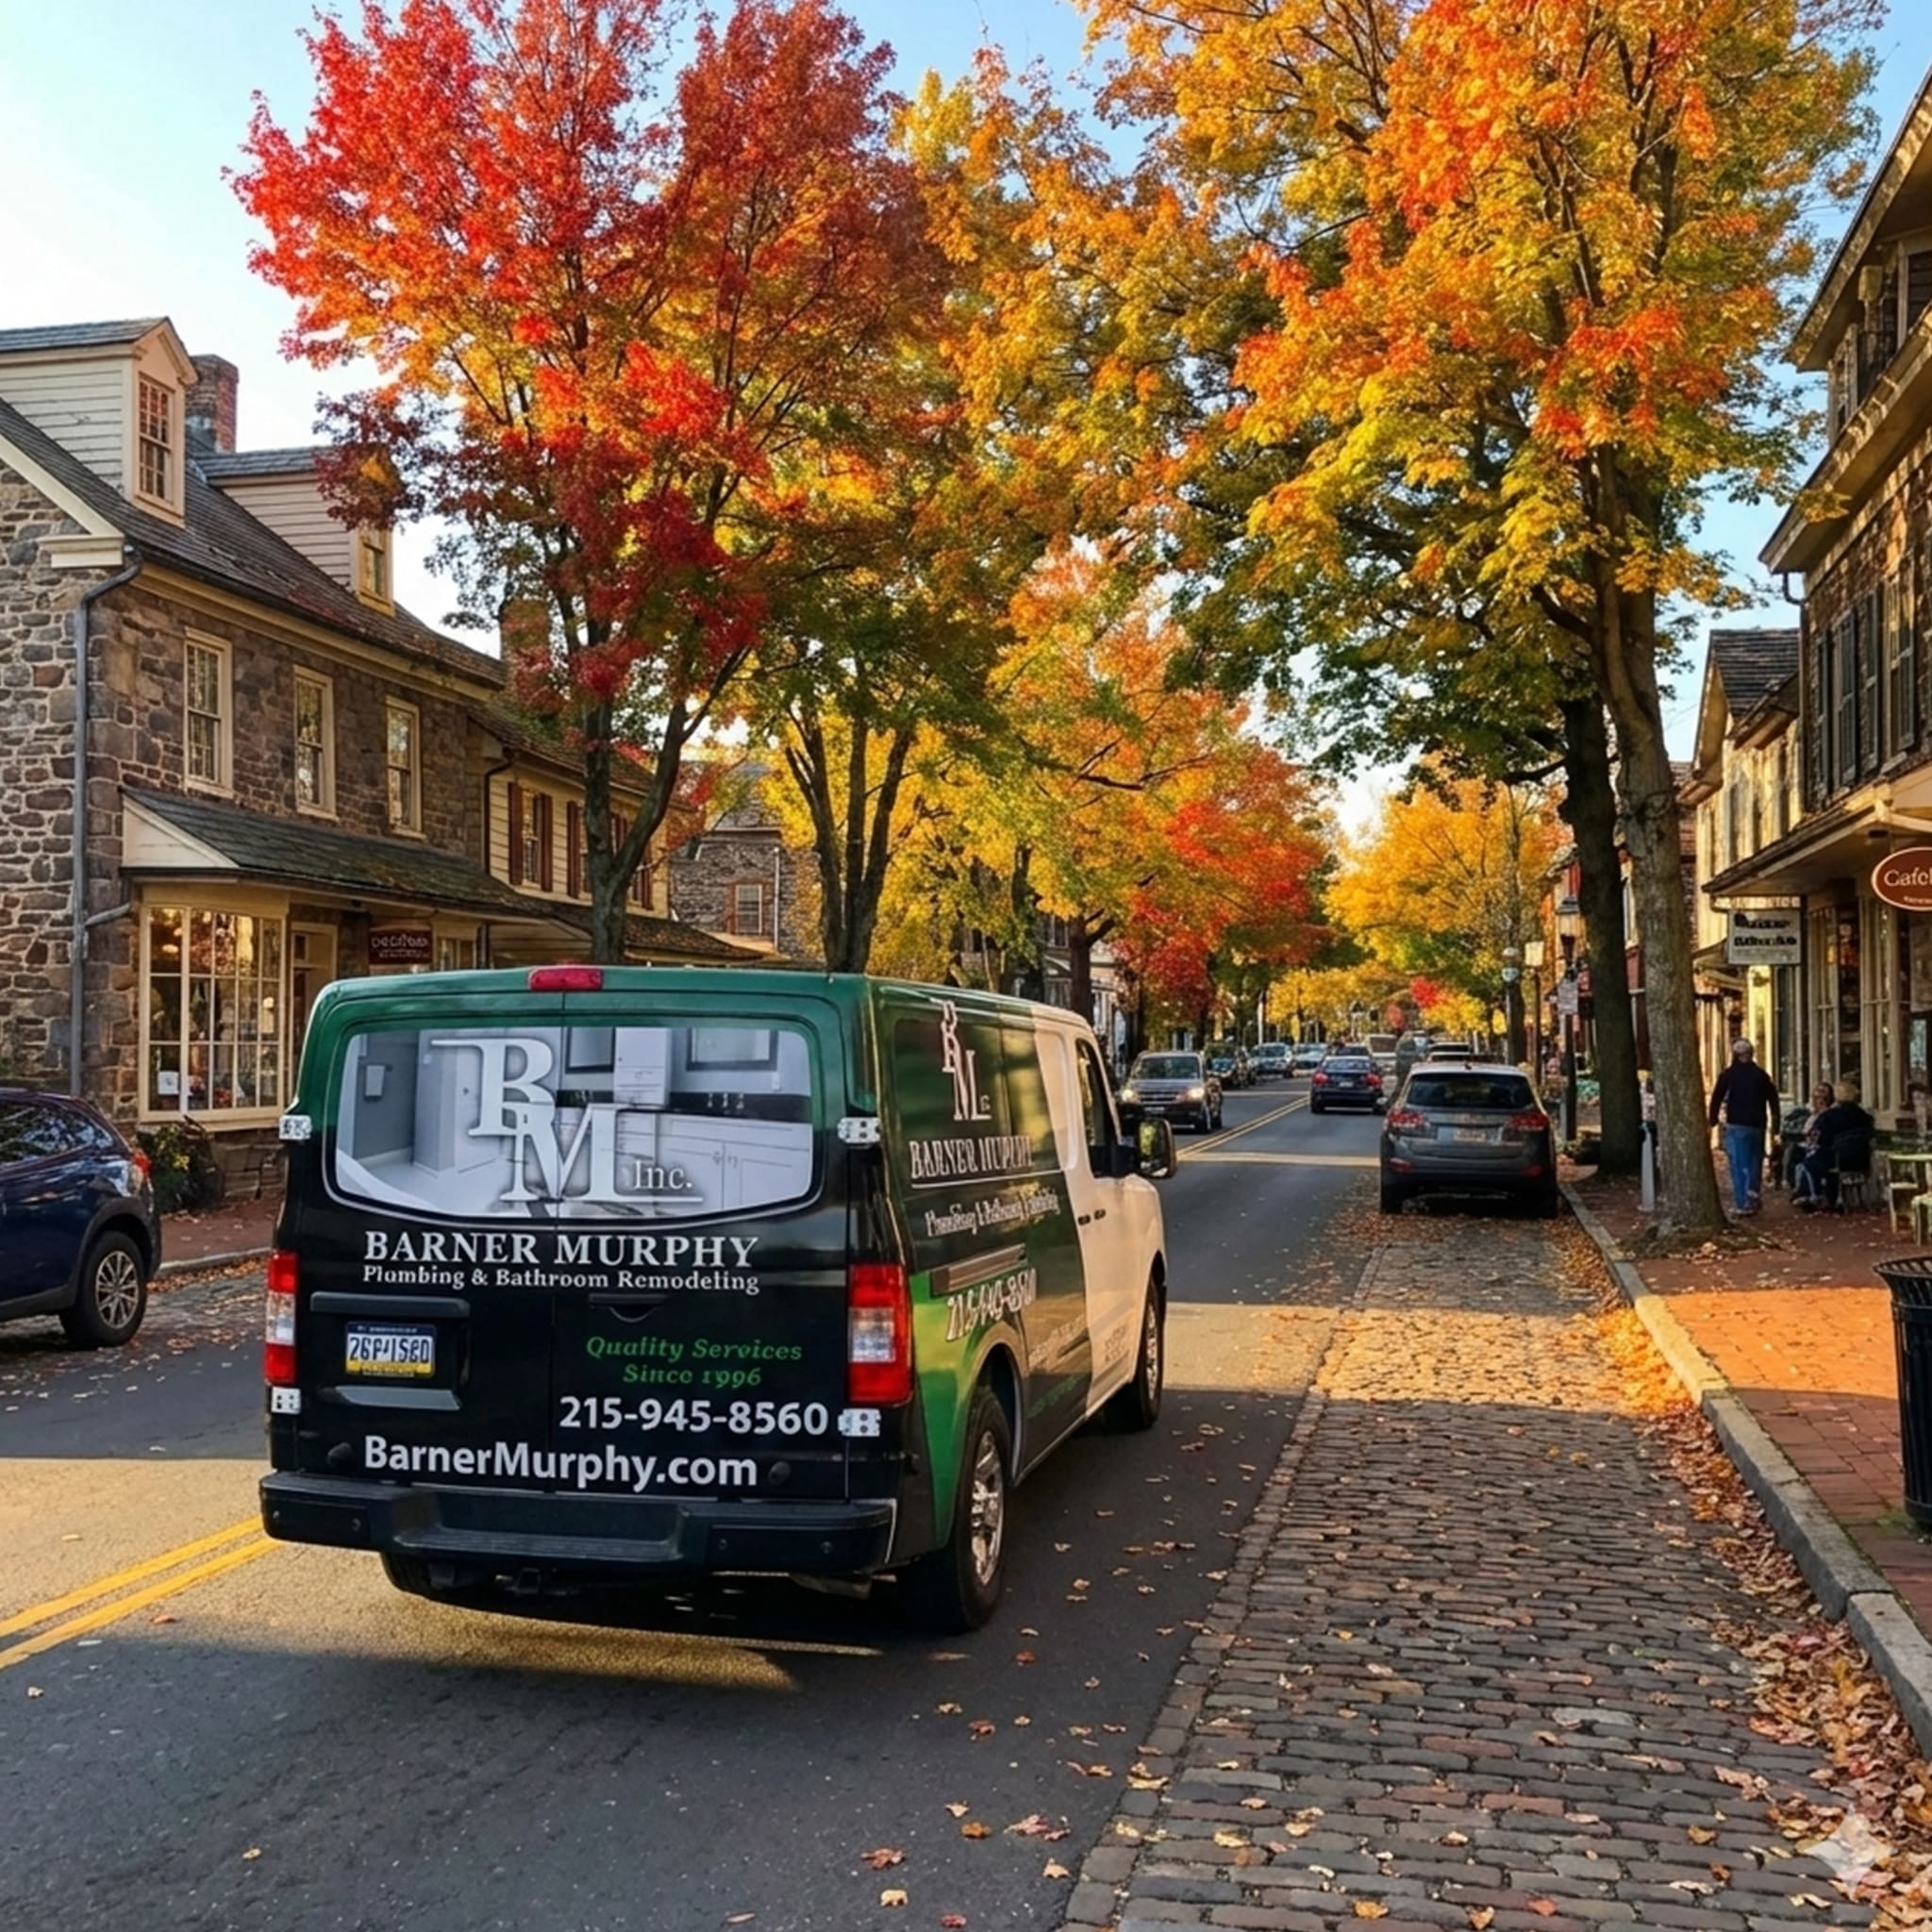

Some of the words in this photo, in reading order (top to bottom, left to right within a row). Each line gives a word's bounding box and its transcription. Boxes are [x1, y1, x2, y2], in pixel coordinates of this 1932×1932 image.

[632, 1160, 693, 1190] Inc.
[363, 1230, 541, 1264] BARNER
[553, 1234, 758, 1268] MURPHY
[472, 1268, 489, 1286] &
[495, 1269, 608, 1288] Bathroom
[617, 1270, 759, 1295] Remodeling
[586, 1336, 684, 1363] Quality
[691, 1339, 802, 1360] Services
[623, 1364, 693, 1385] Since
[702, 1367, 762, 1390] 1996
[559, 1396, 829, 1436] 215-945-8560
[364, 1436, 758, 1492] BarnerMurphy.com
